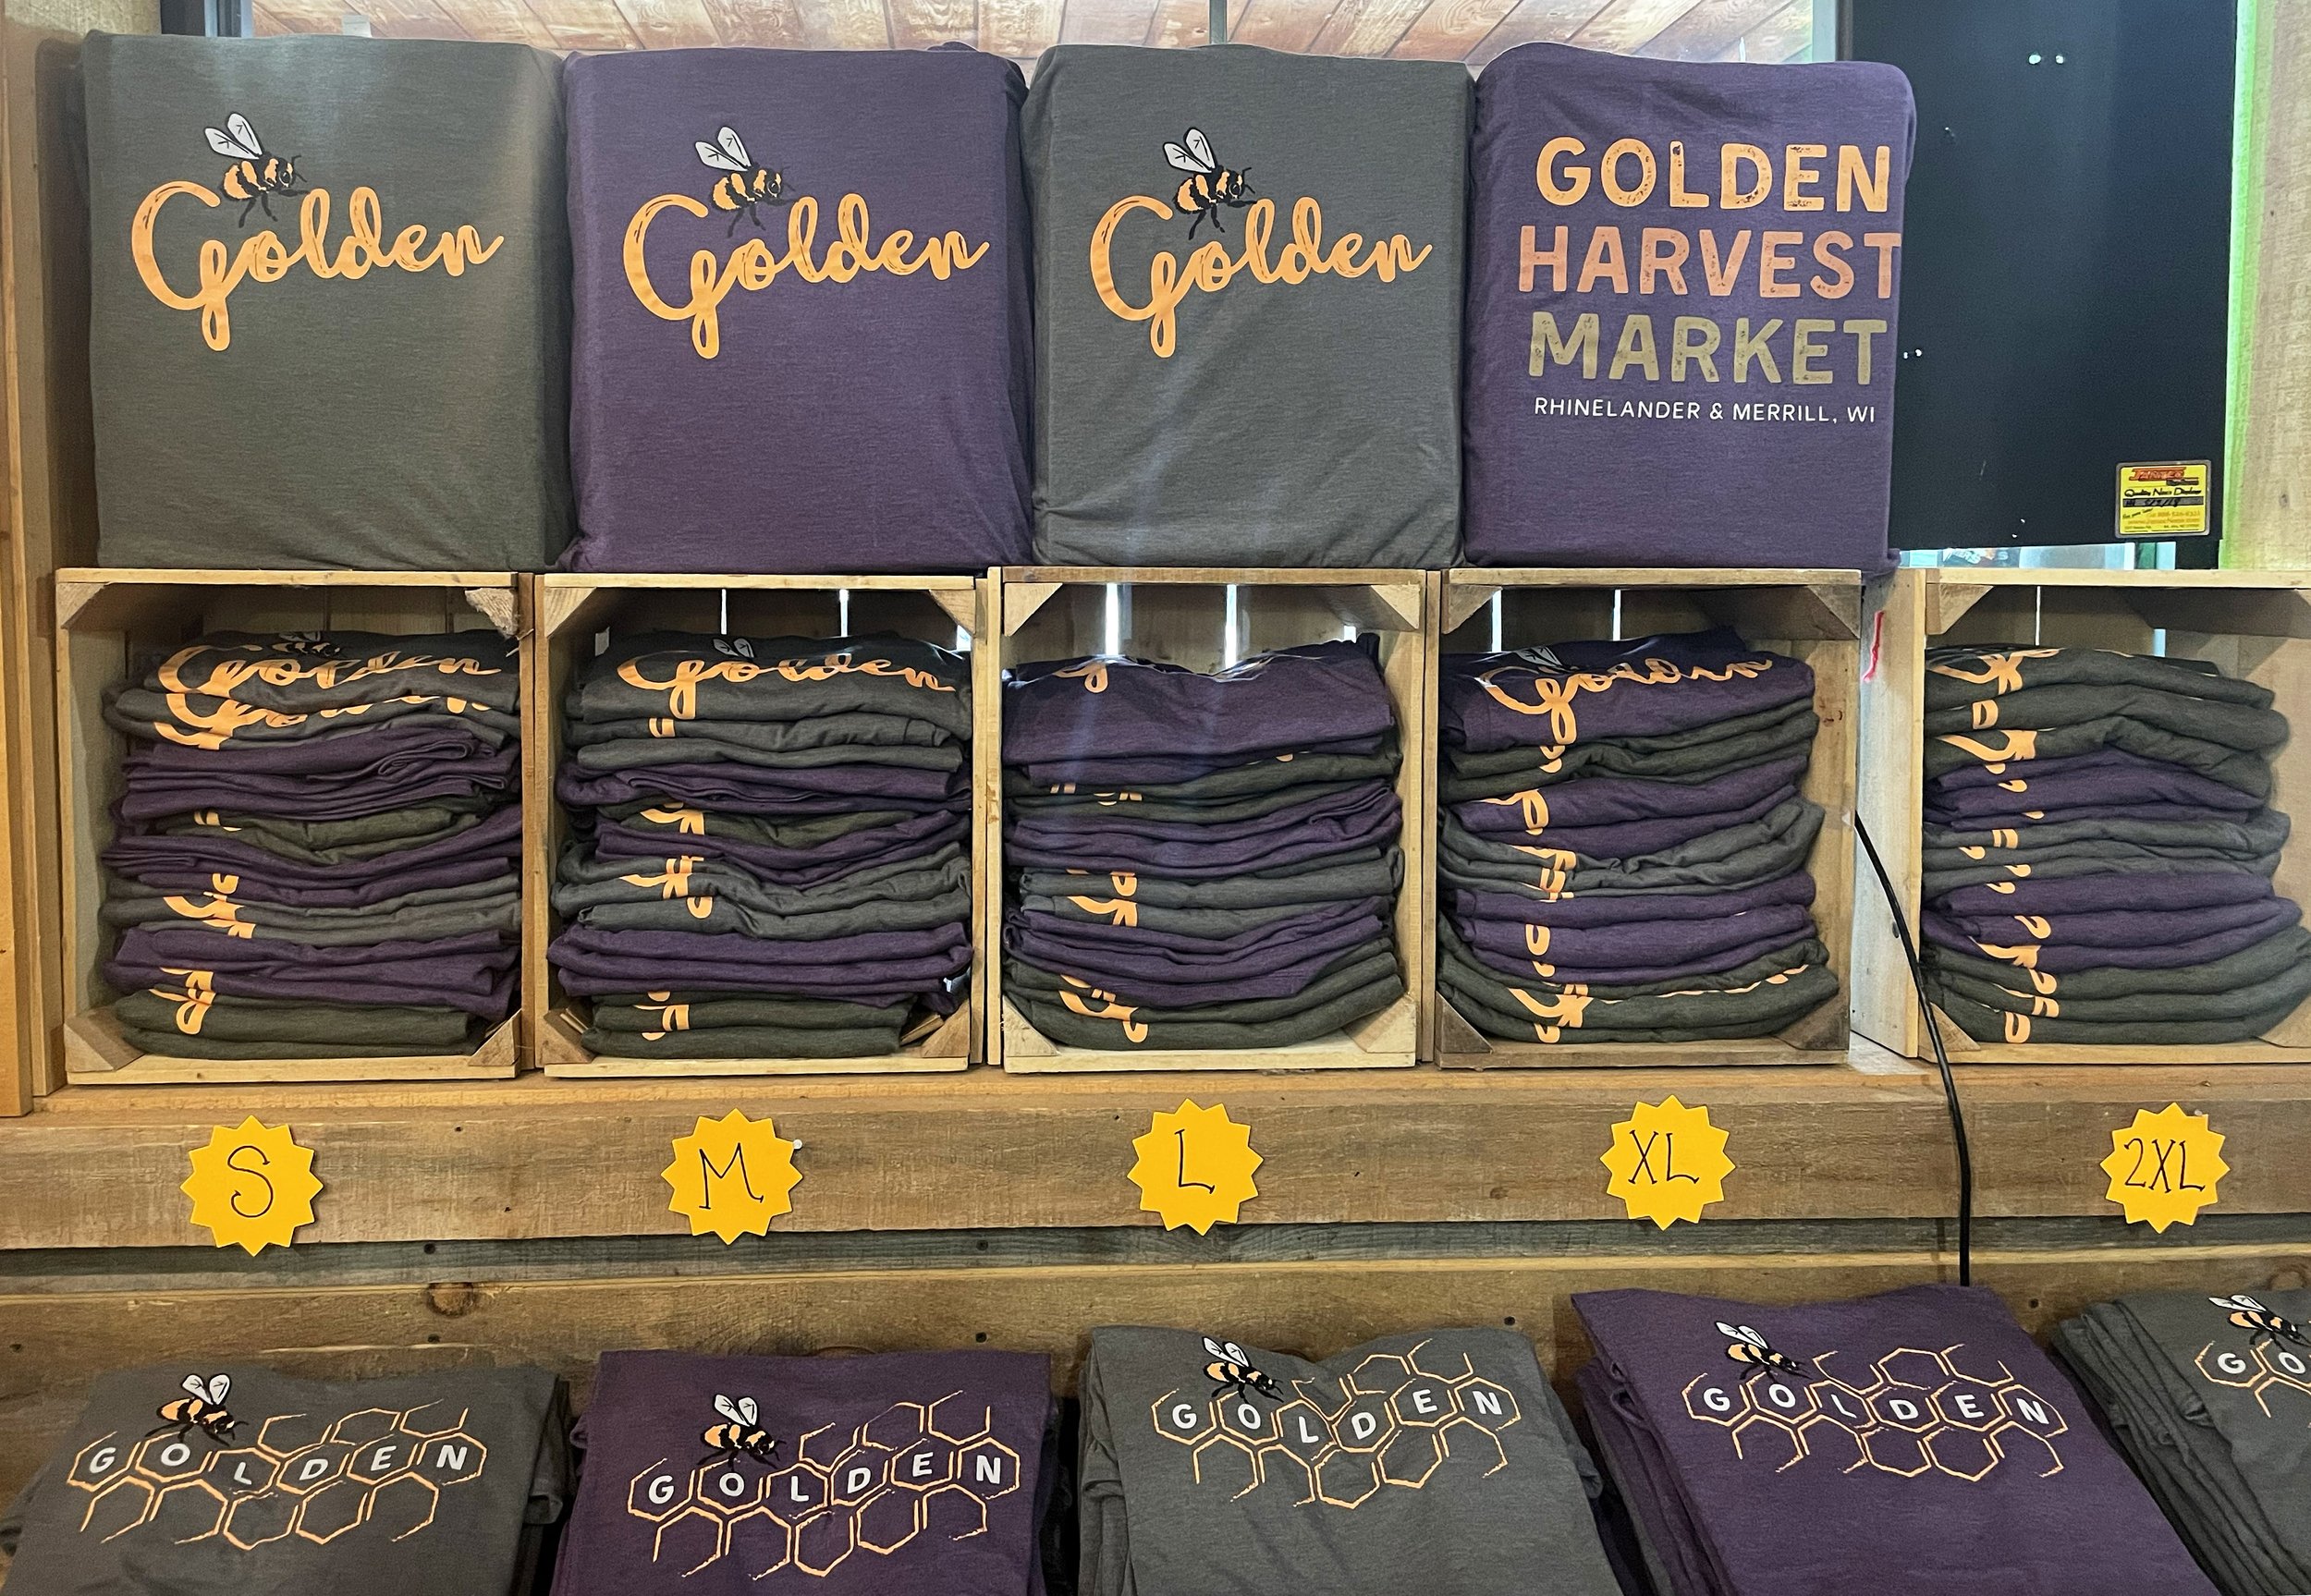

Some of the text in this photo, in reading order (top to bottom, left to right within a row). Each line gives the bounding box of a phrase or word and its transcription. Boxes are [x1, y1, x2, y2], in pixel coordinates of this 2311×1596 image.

[1536, 136, 1890, 213] GOLDEN
[131, 180, 505, 351] Golden
[622, 192, 990, 359] Golden
[1090, 195, 1433, 358] Golden
[1519, 225, 1901, 299] HARVEST
[1528, 311, 1888, 385] MARKET
[1535, 396, 1876, 424] RHINELANDER & MERRILL, WI
[227, 1145, 274, 1218] S
[699, 1142, 764, 1210] M
[1174, 1129, 1216, 1195] L
[1629, 1130, 1700, 1185] XL
[2123, 1138, 2206, 1194] 2XL
[1172, 1388, 1503, 1444] GOLDEN
[1703, 1384, 2049, 1425] GOLDEN
[89, 1443, 468, 1485] GOLDEN
[648, 1451, 1001, 1505] GOLDEN
